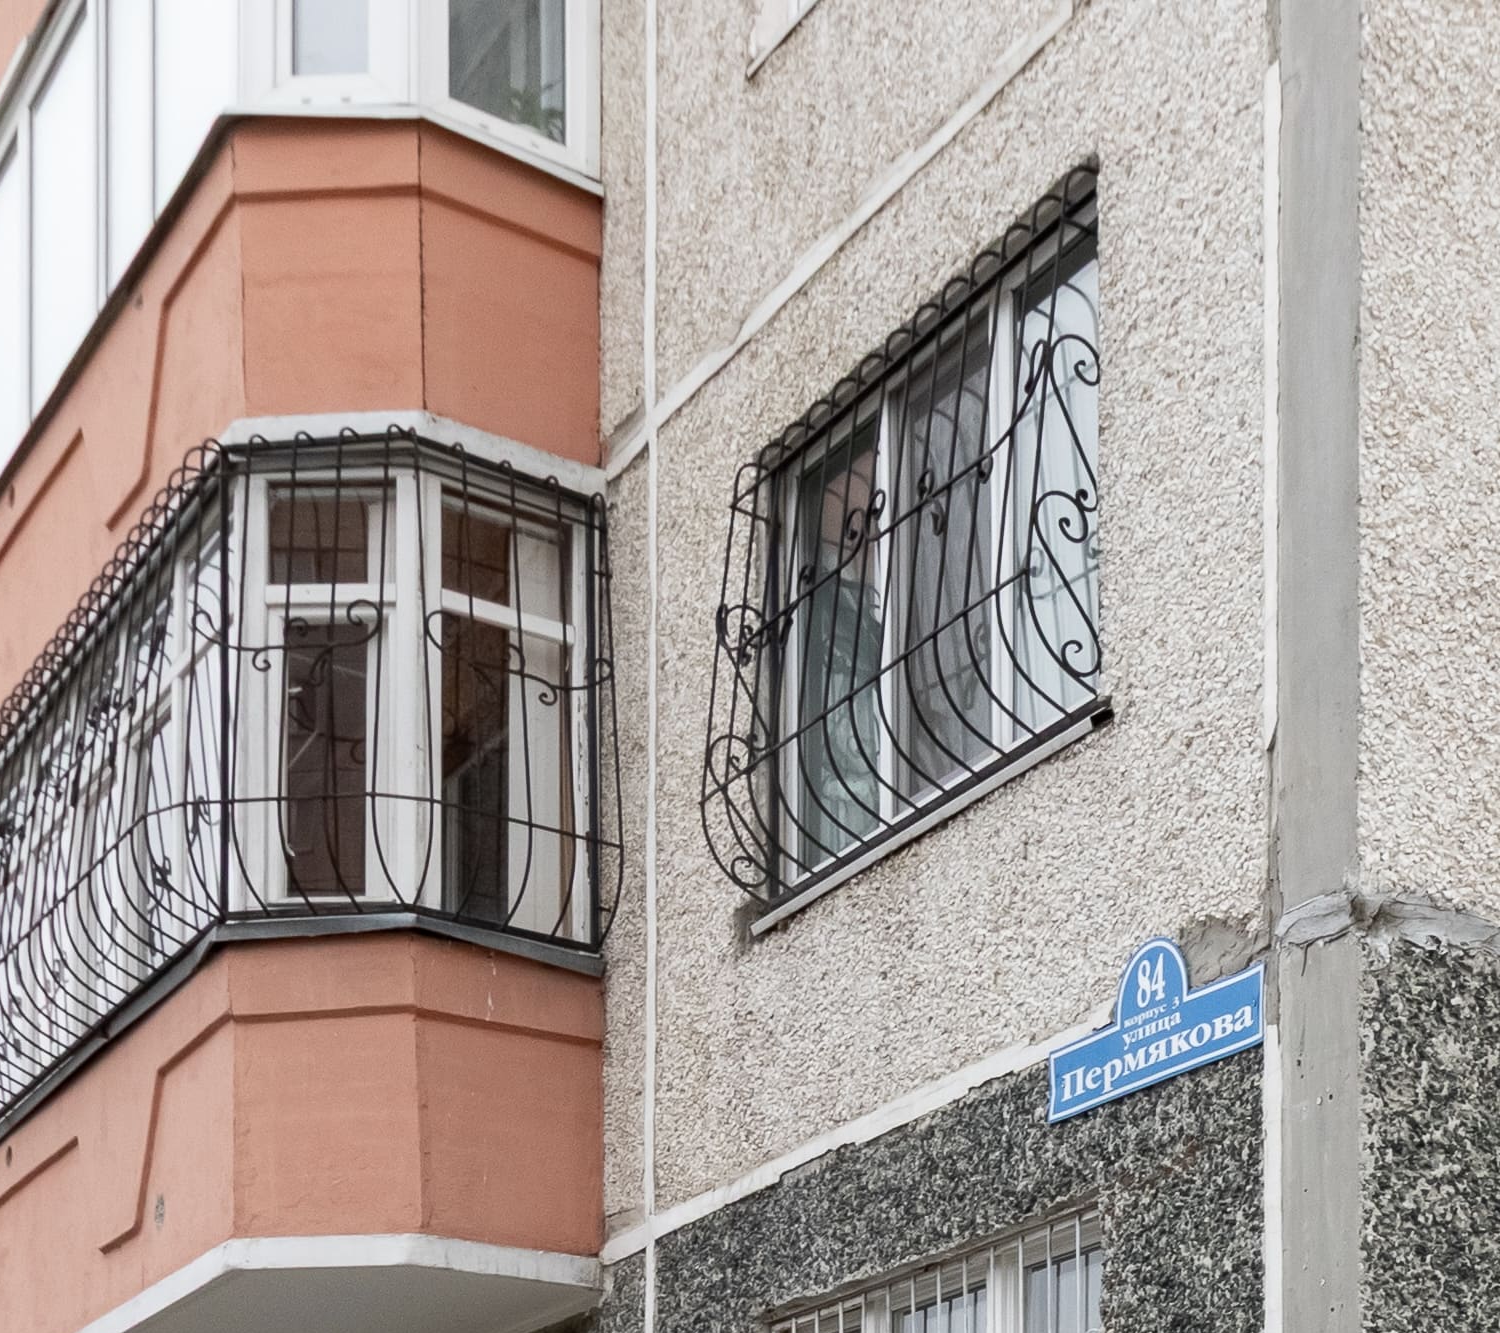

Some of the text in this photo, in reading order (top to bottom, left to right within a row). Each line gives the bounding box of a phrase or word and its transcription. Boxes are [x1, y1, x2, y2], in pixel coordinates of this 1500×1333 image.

[1136, 953, 1166, 1008] 84
[1122, 1012, 1182, 1050] улица
[1123, 996, 1180, 1029] корпус 3
[1061, 1004, 1255, 1101] Пермякова
